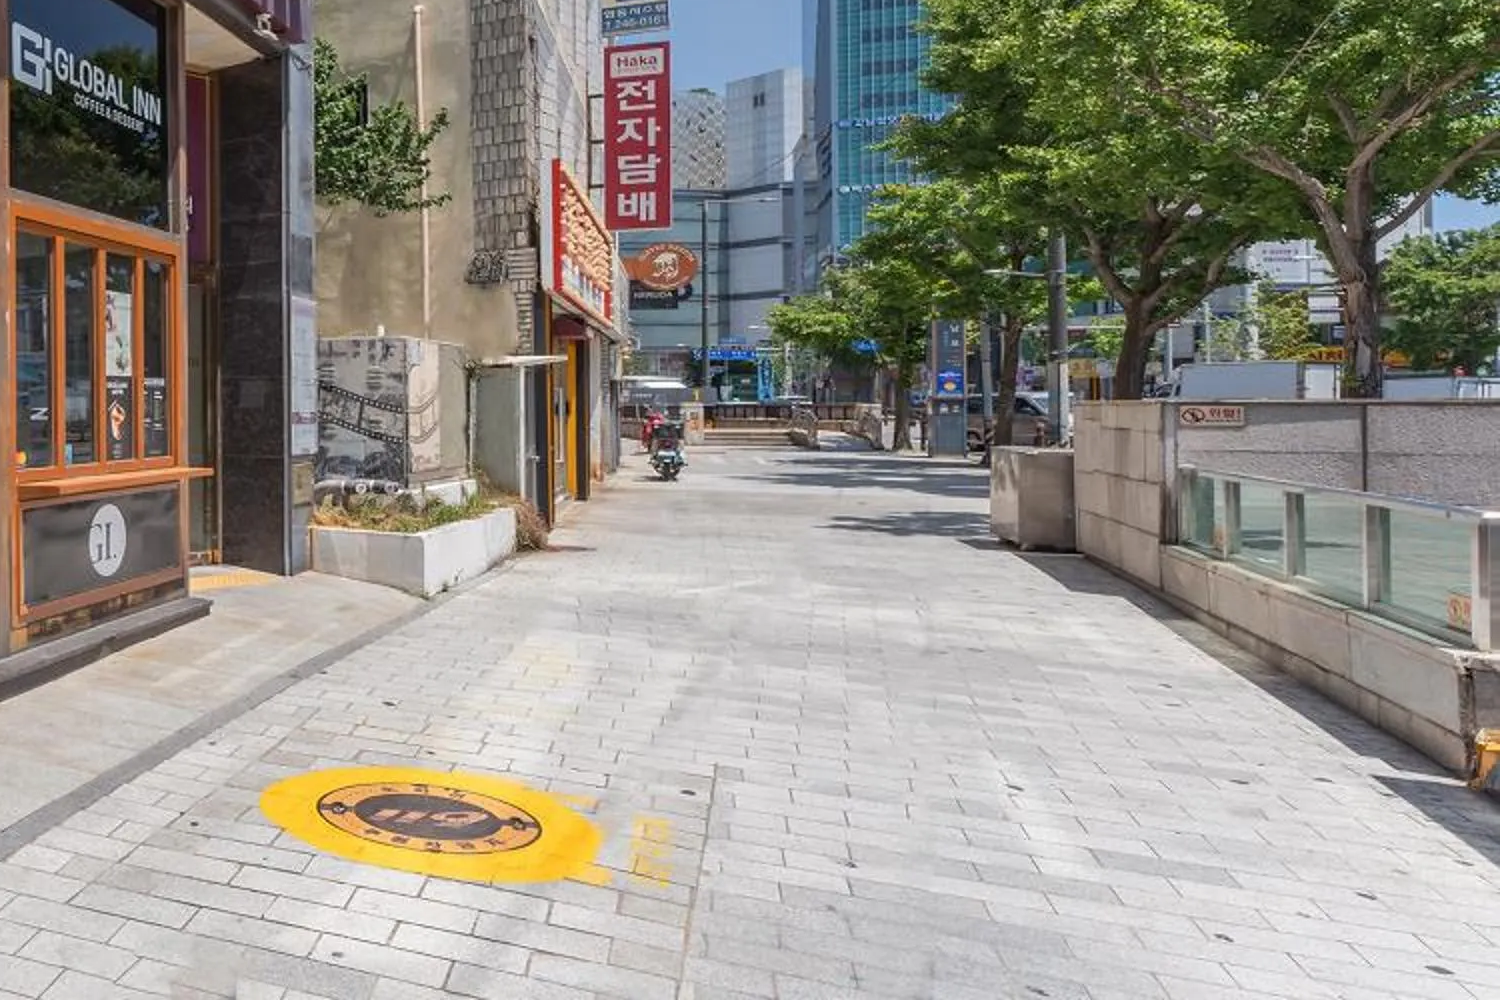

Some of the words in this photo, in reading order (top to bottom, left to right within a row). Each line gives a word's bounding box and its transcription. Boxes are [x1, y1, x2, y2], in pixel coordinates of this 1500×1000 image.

[54, 47, 130, 111] GLOBAL
[133, 85, 161, 126] INN
[616, 79, 661, 222] 전자담배
